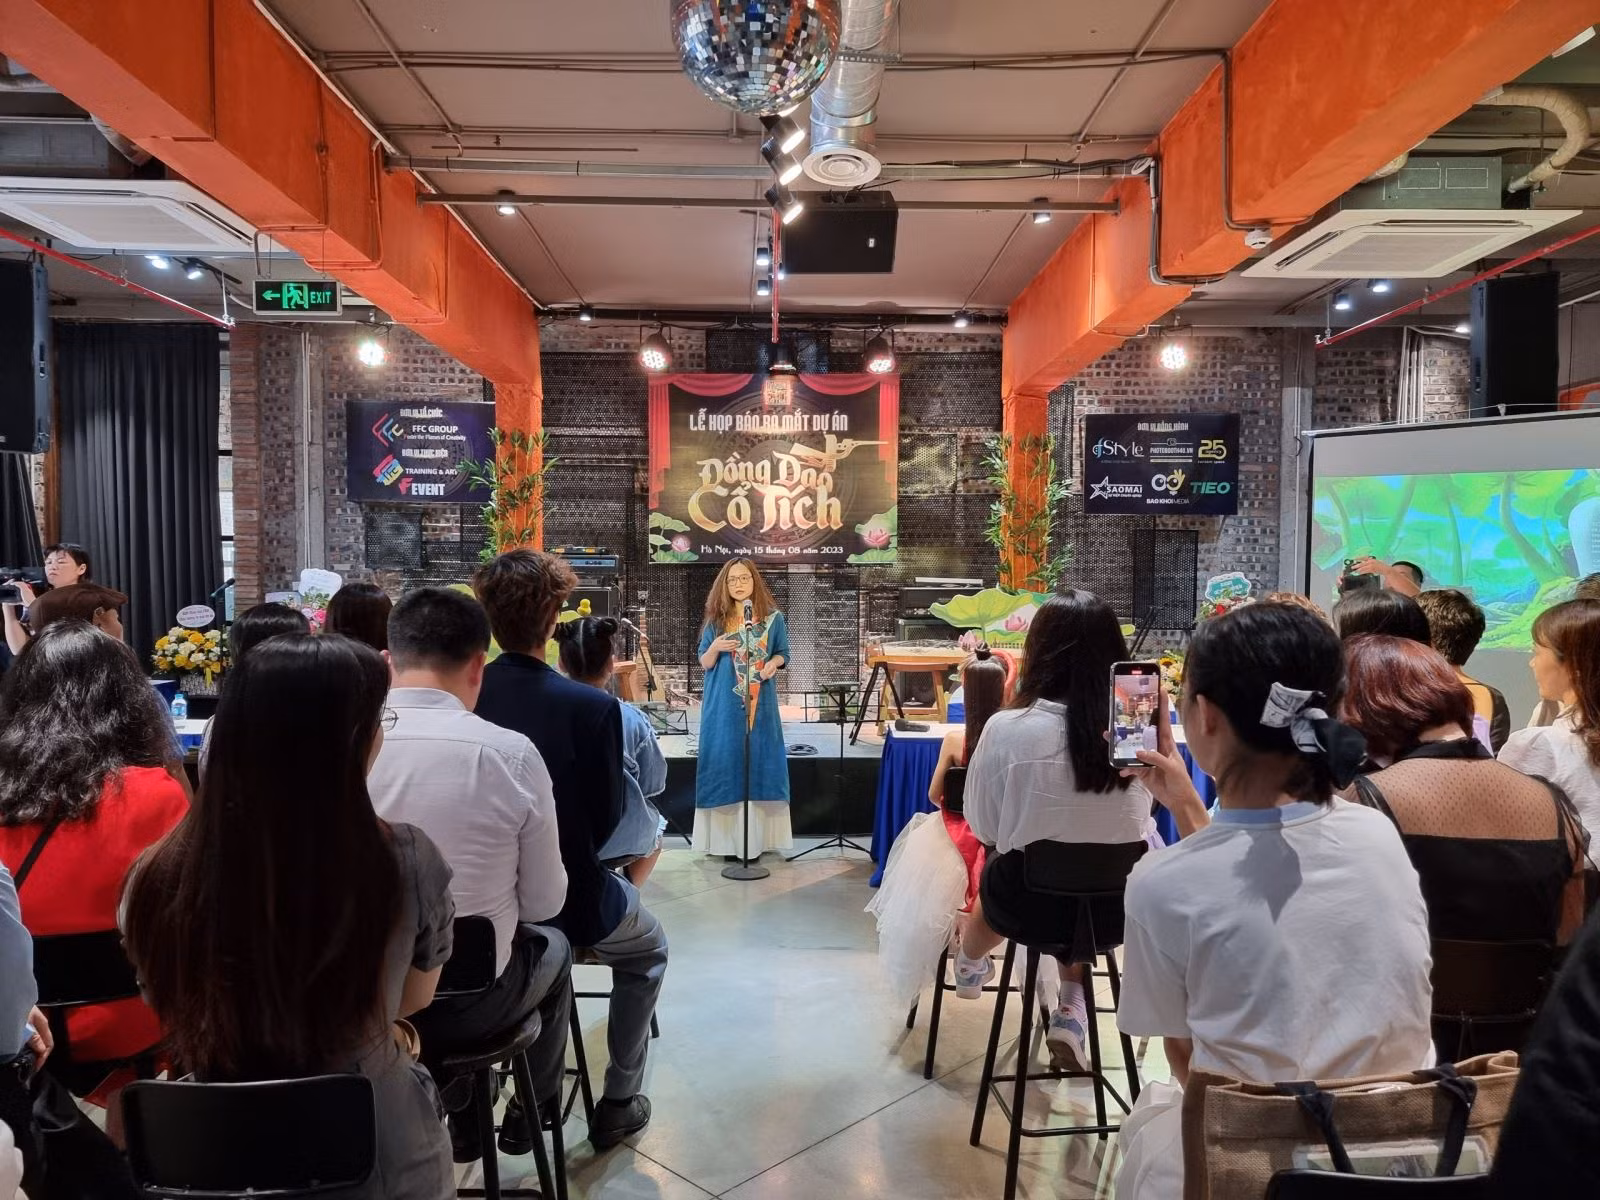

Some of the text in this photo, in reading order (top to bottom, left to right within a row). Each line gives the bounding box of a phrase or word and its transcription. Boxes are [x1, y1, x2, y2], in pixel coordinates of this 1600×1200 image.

[310, 291, 331, 304] EXIT
[689, 408, 707, 431] LỄ
[709, 414, 733, 434] HỌP
[735, 410, 760, 432] BÁO
[782, 408, 810, 432] MẮT
[812, 414, 830, 434] DỰ
[832, 410, 848, 431] ÁN
[412, 425, 459, 434] FFC GROUP
[1198, 439, 1227, 460] 25
[696, 450, 833, 492] Đồng Dao
[1107, 486, 1143, 494] SAOMAI
[1190, 481, 1230, 494] TIEO
[687, 480, 844, 533] Cổ Tích
[701, 544, 712, 553] Hà
[734, 546, 752, 556] ngày
[754, 546, 764, 554] 15
[765, 545, 786, 556] tháng
[787, 546, 801, 554] 08
[820, 546, 844, 554] 2023
